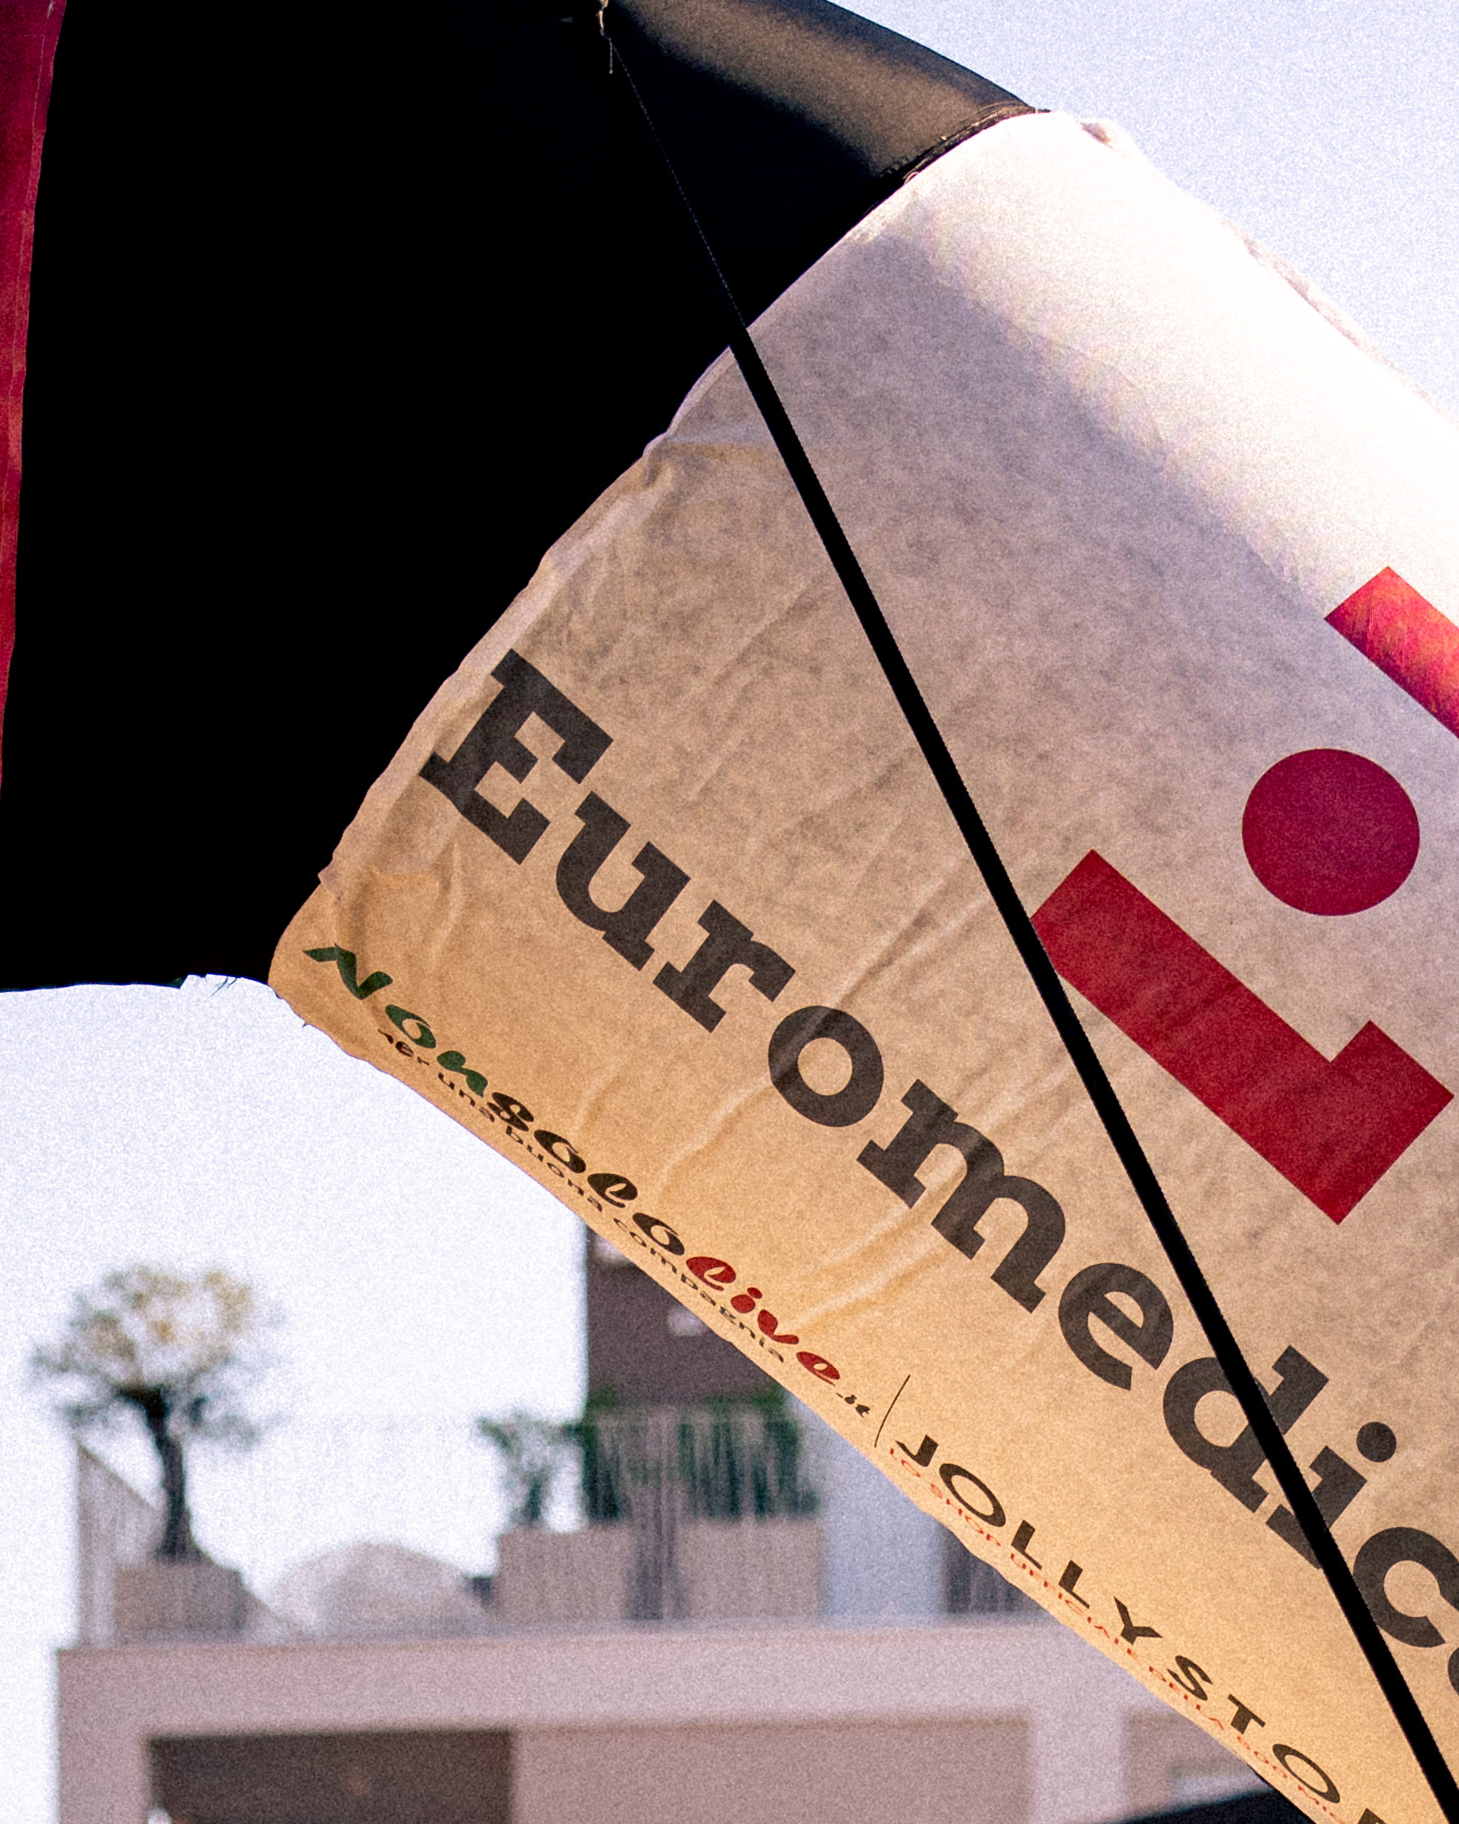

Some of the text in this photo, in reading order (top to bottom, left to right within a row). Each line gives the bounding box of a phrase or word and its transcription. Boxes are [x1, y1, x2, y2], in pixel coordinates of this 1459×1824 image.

[419, 648, 1459, 1697] Euromedic
[437, 1071, 496, 1123] una
[505, 1125, 603, 1212] buona
[612, 1217, 785, 1363] compagnia
[929, 1482, 1002, 1547] SHOP
[1010, 1552, 1139, 1661] UFFICIALE
[1148, 1665, 1225, 1732] DELLA
